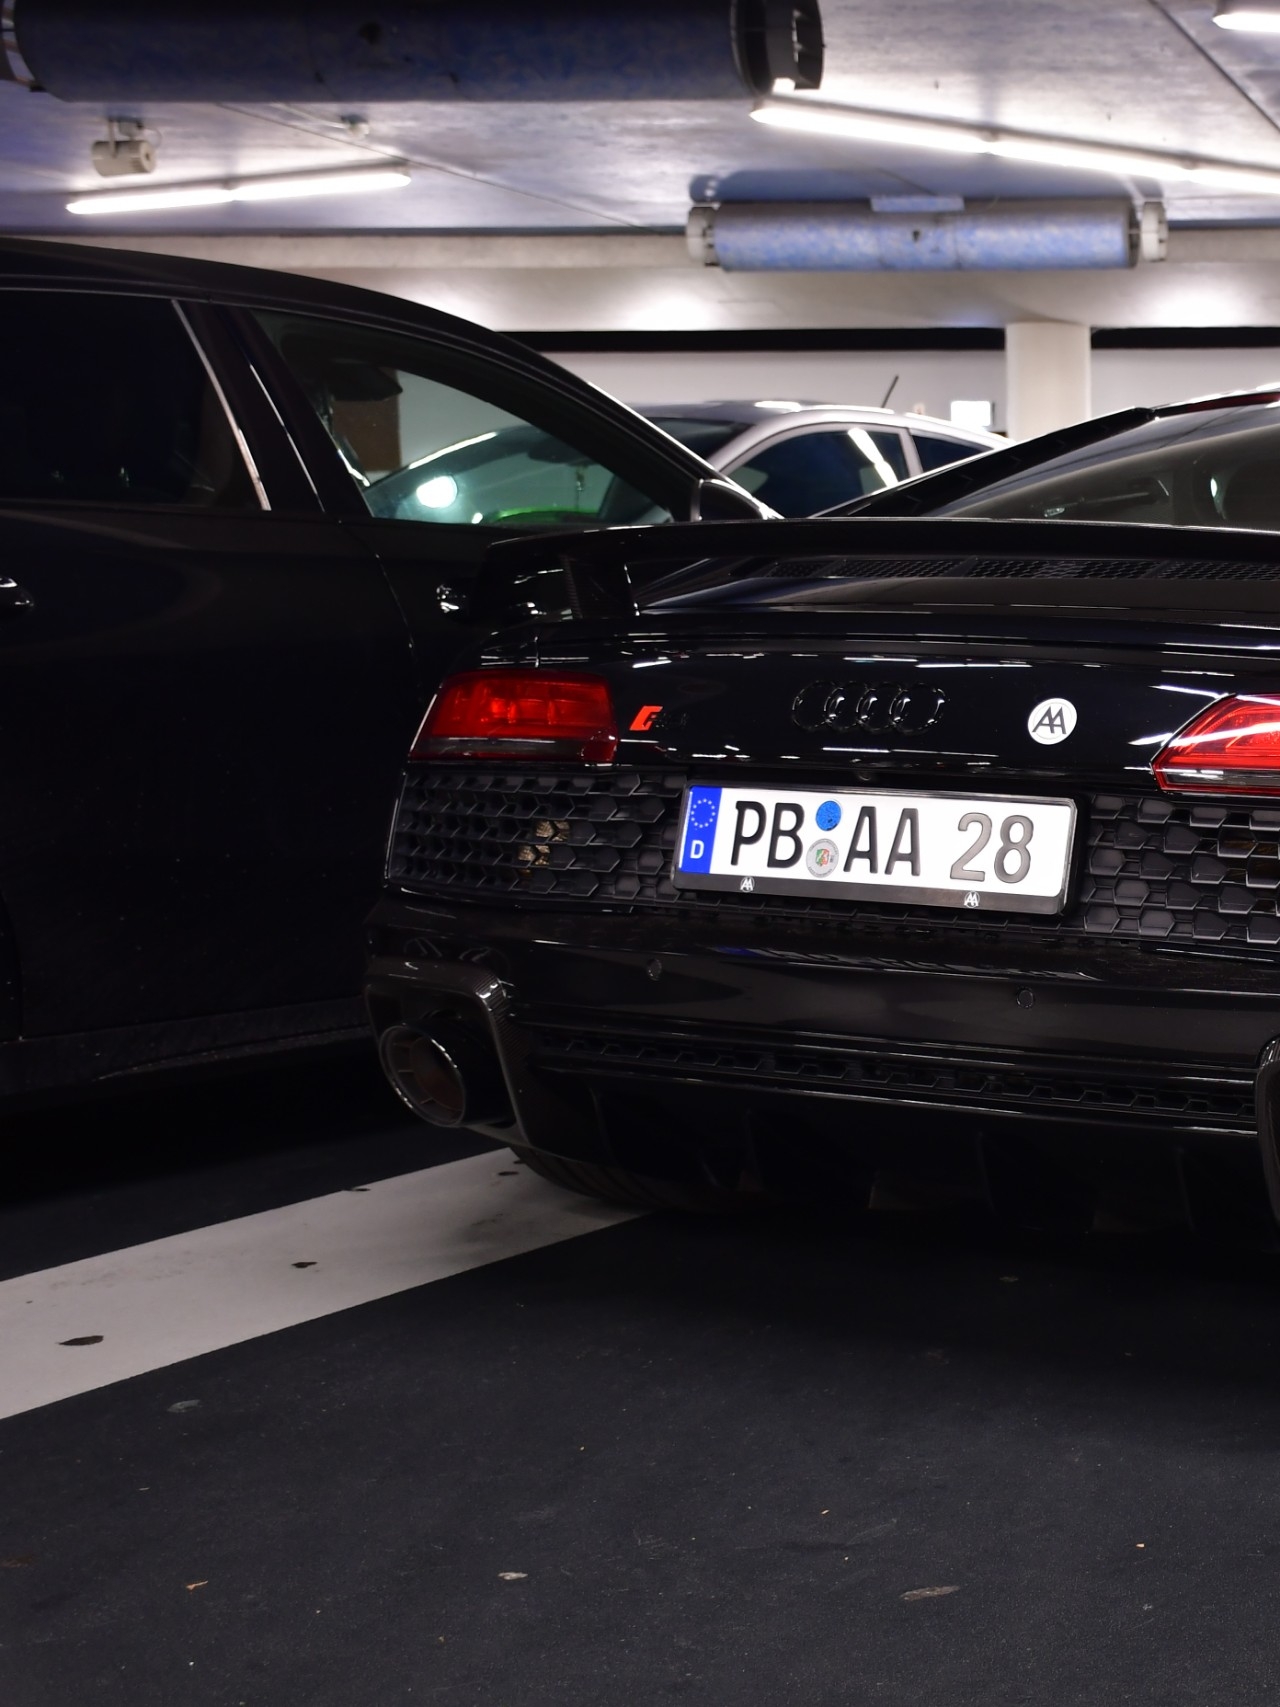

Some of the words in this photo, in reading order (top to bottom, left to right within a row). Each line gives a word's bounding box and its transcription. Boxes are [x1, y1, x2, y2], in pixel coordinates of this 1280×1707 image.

[690, 839, 704, 860] D
[730, 800, 804, 868] PB
[843, 805, 921, 876] AA
[949, 812, 1035, 884] 28
